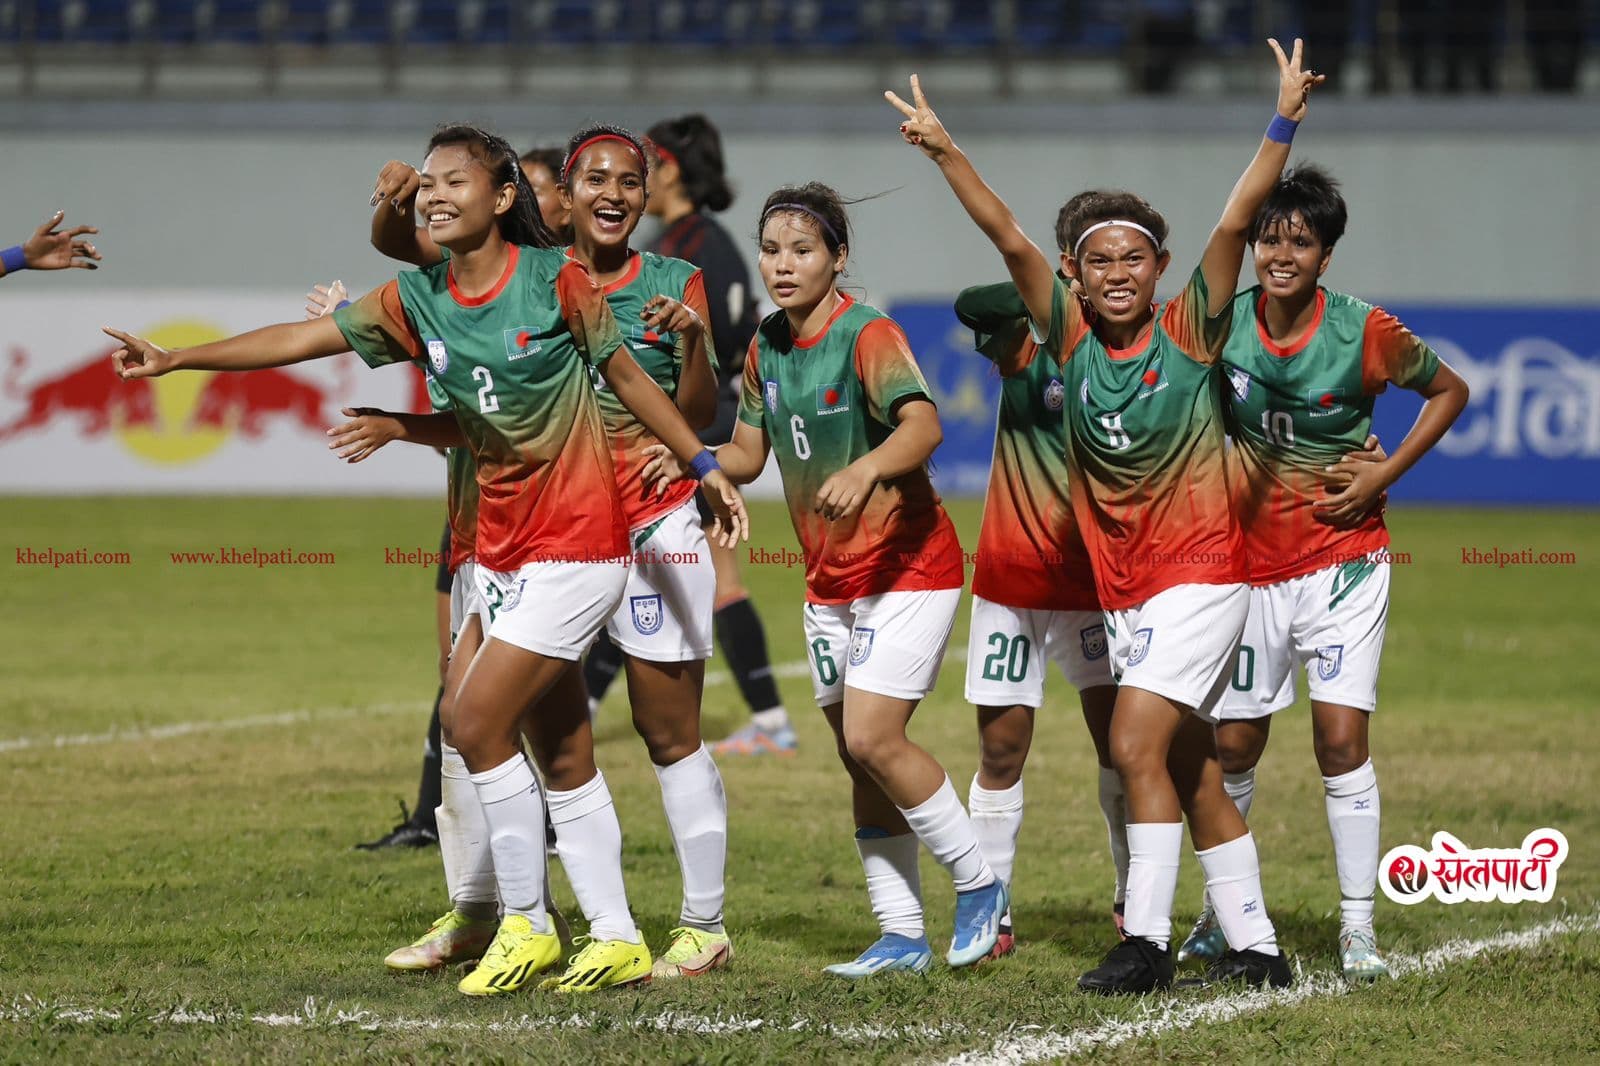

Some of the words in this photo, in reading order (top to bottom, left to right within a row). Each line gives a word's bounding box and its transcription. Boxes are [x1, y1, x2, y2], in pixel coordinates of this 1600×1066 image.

[471, 365, 499, 414] 2
[790, 414, 811, 460] 6
[1101, 411, 1131, 449] 8
[1261, 410, 1295, 448] 10
[811, 637, 839, 686] 6
[982, 632, 1030, 683] 20
